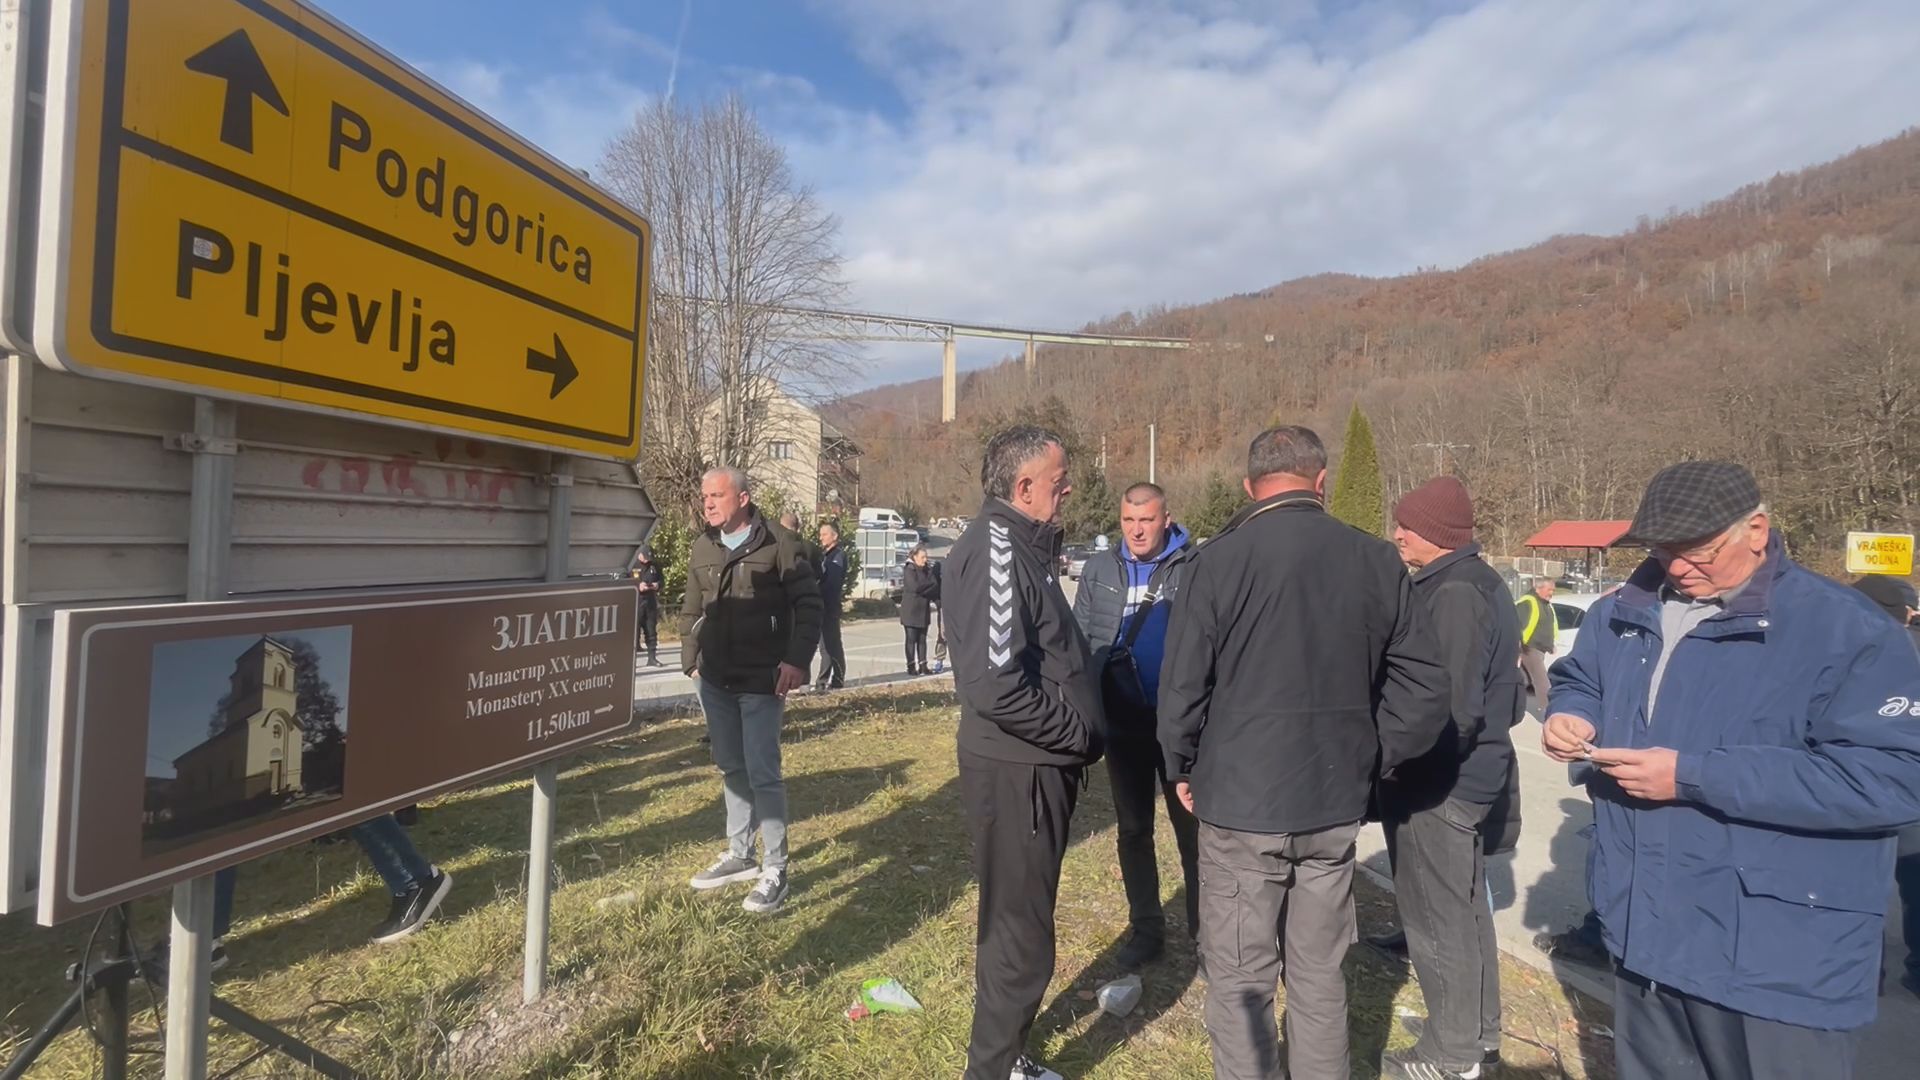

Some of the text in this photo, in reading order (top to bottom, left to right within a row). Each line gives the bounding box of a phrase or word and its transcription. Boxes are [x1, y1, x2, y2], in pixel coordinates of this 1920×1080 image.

[328, 101, 592, 285] Podgorica
[175, 218, 457, 372] Pljevlja
[1856, 540, 1907, 553] VRANEŠKA
[1864, 554, 1899, 565] DOLINA
[491, 605, 619, 651] ЗЛАТЕШ
[467, 664, 545, 691] Манастир
[574, 651, 607, 671] вијек
[466, 672, 616, 719] Monastery XX century
[527, 710, 590, 742] 11,50km
